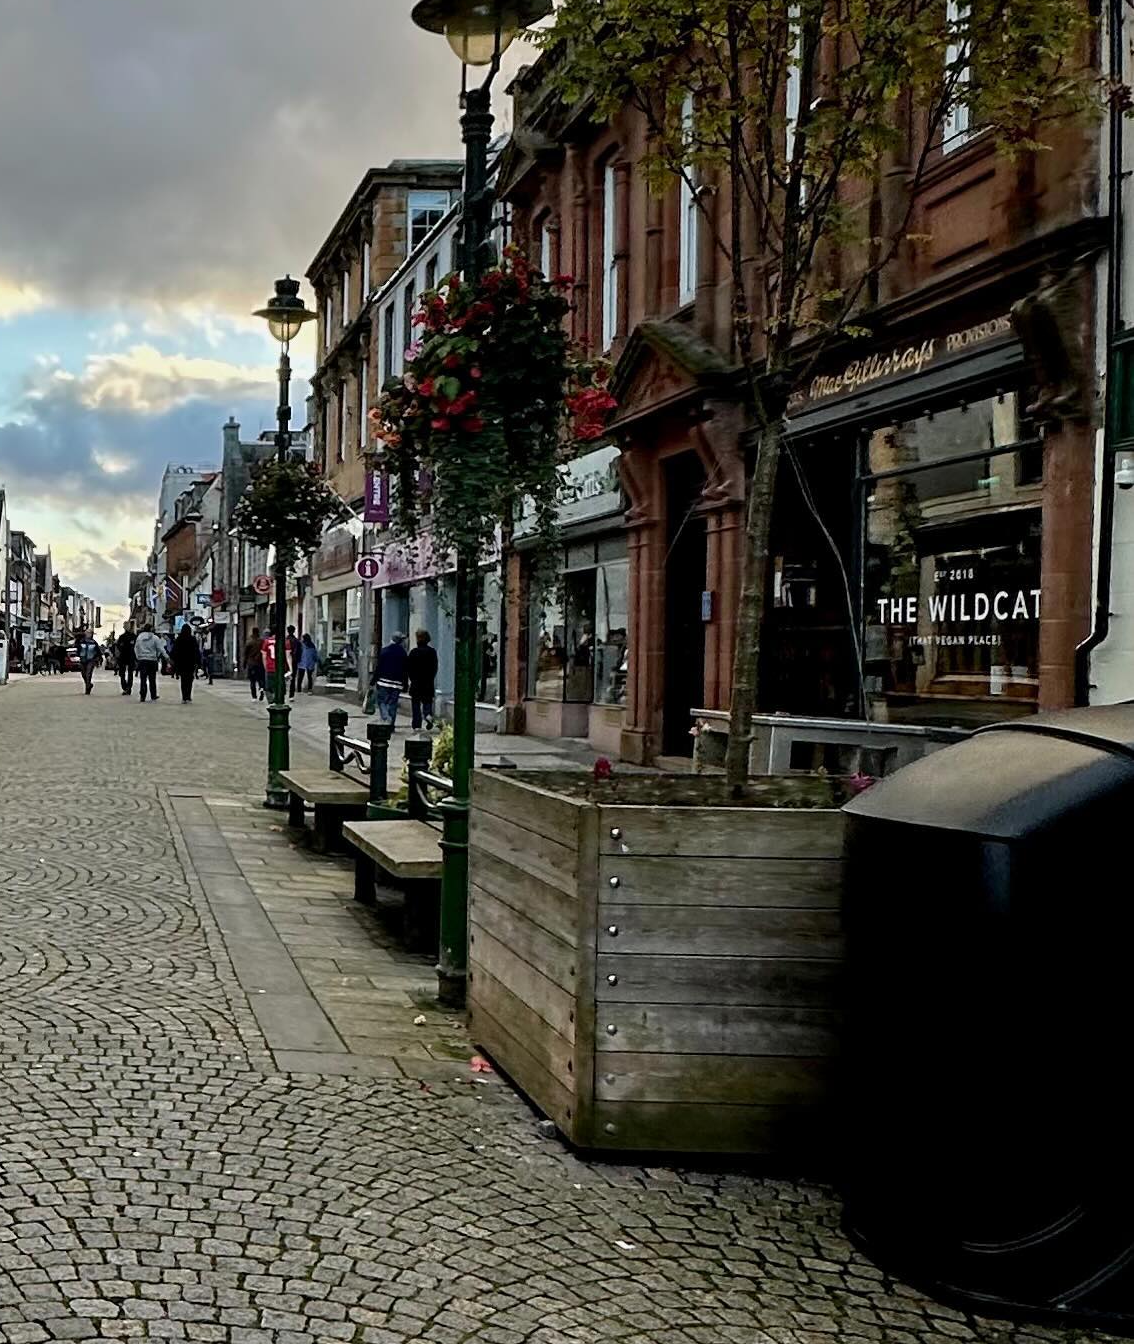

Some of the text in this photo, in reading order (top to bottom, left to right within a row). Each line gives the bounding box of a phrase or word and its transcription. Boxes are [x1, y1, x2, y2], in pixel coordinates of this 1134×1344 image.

[877, 589, 1042, 624] THE WILDCAT
[935, 635, 965, 647] VEGAN
